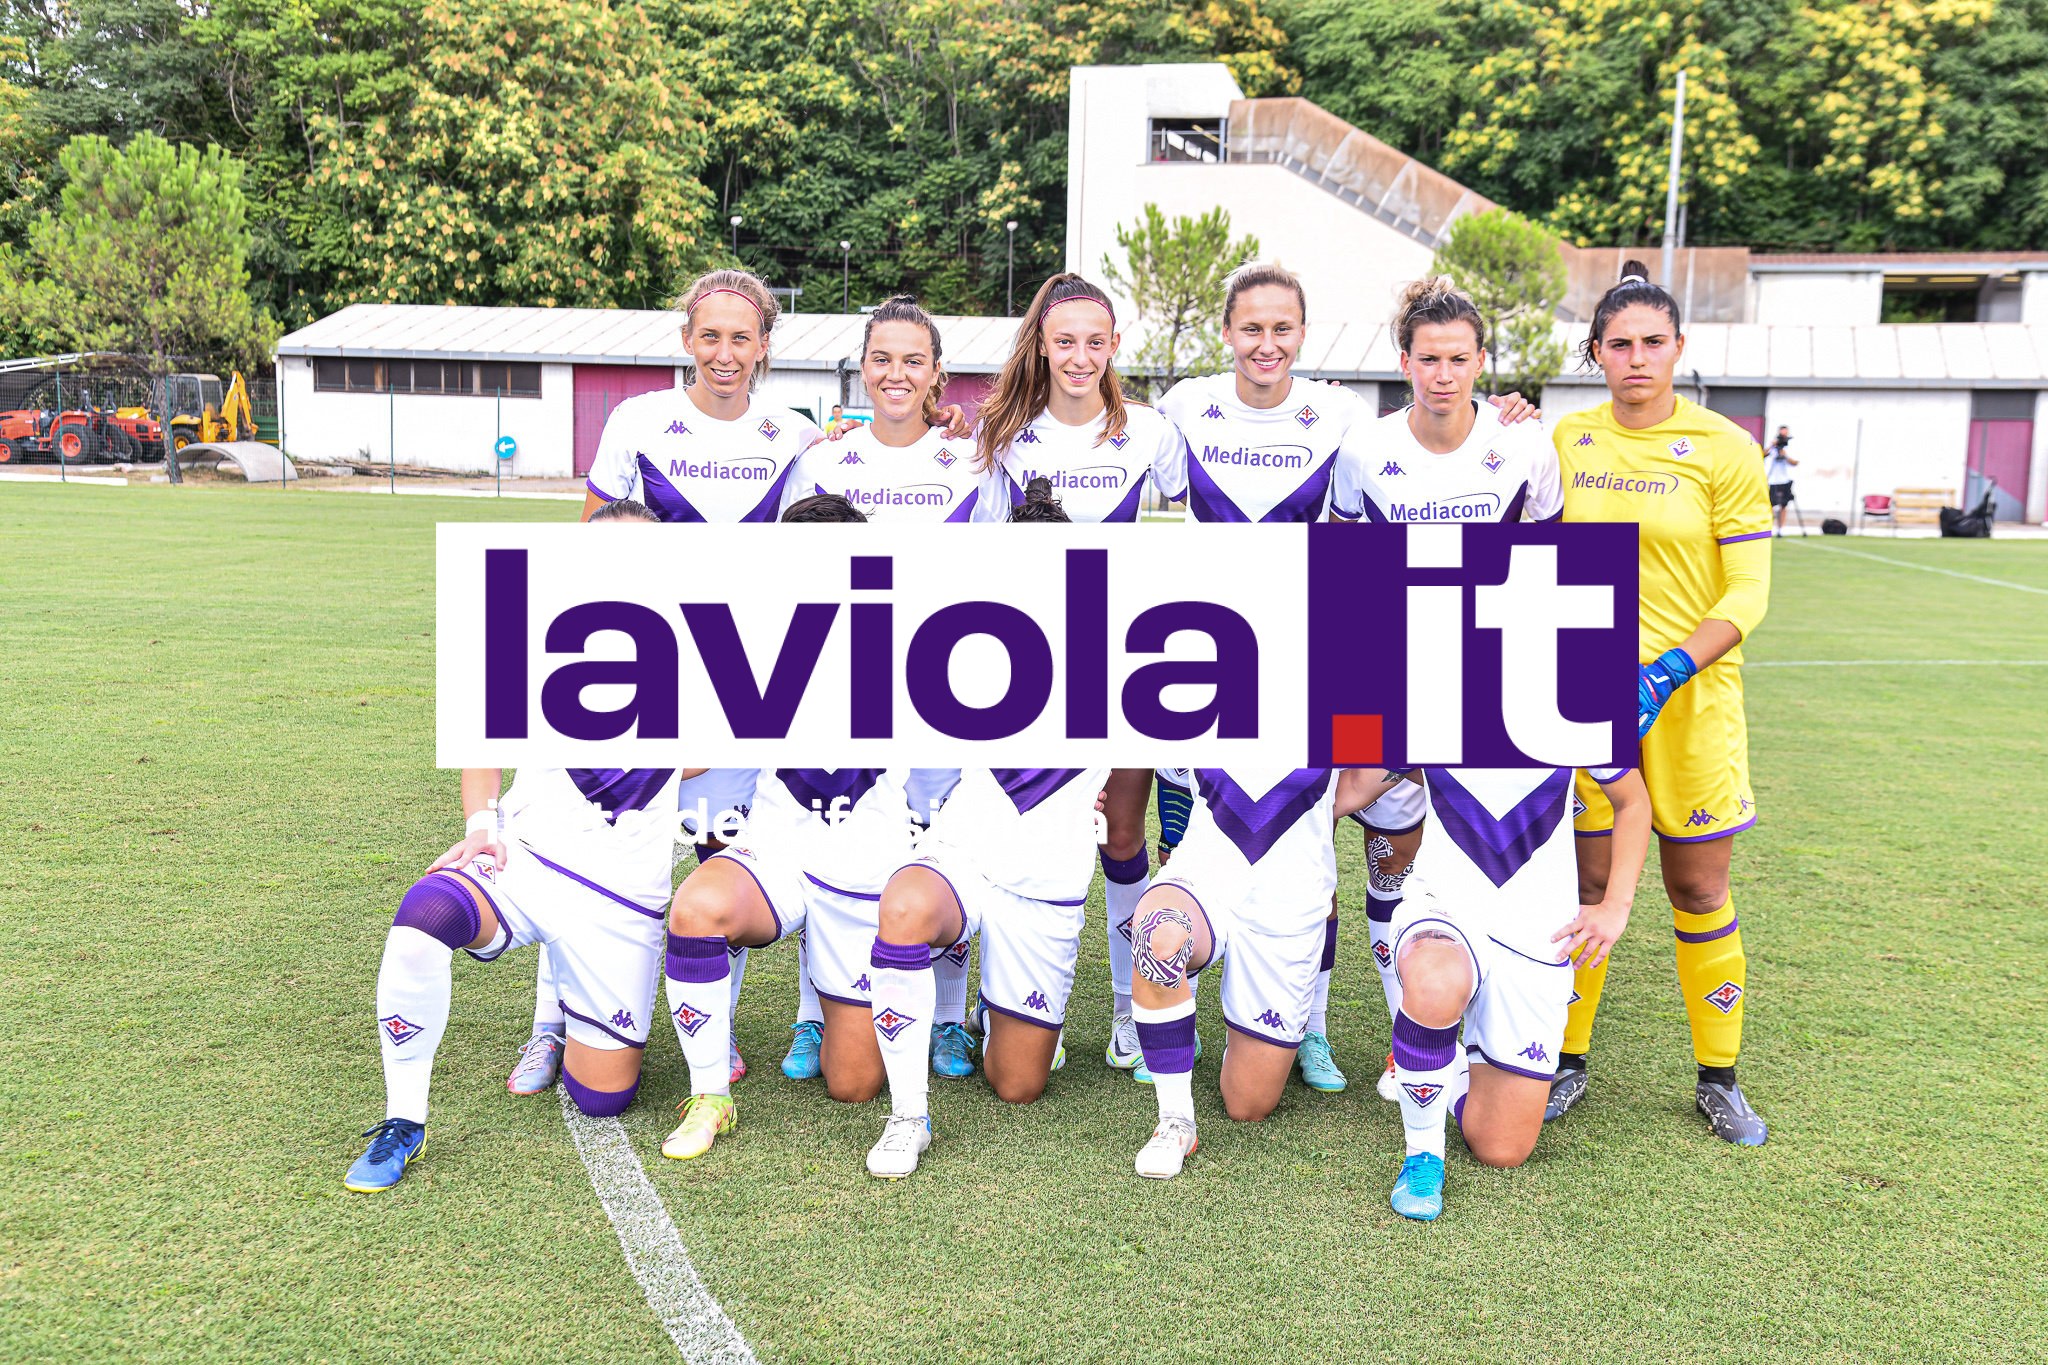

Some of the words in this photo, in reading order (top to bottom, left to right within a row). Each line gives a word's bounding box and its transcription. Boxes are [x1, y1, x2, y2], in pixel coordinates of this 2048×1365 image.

[1202, 445, 1302, 468] Mediacom
[669, 459, 768, 481] Mediacom
[1021, 469, 1119, 489] Mdiacom
[1571, 471, 1666, 494] Mediacom
[844, 487, 944, 506] Mediacom
[1390, 501, 1492, 521] Mediacom
